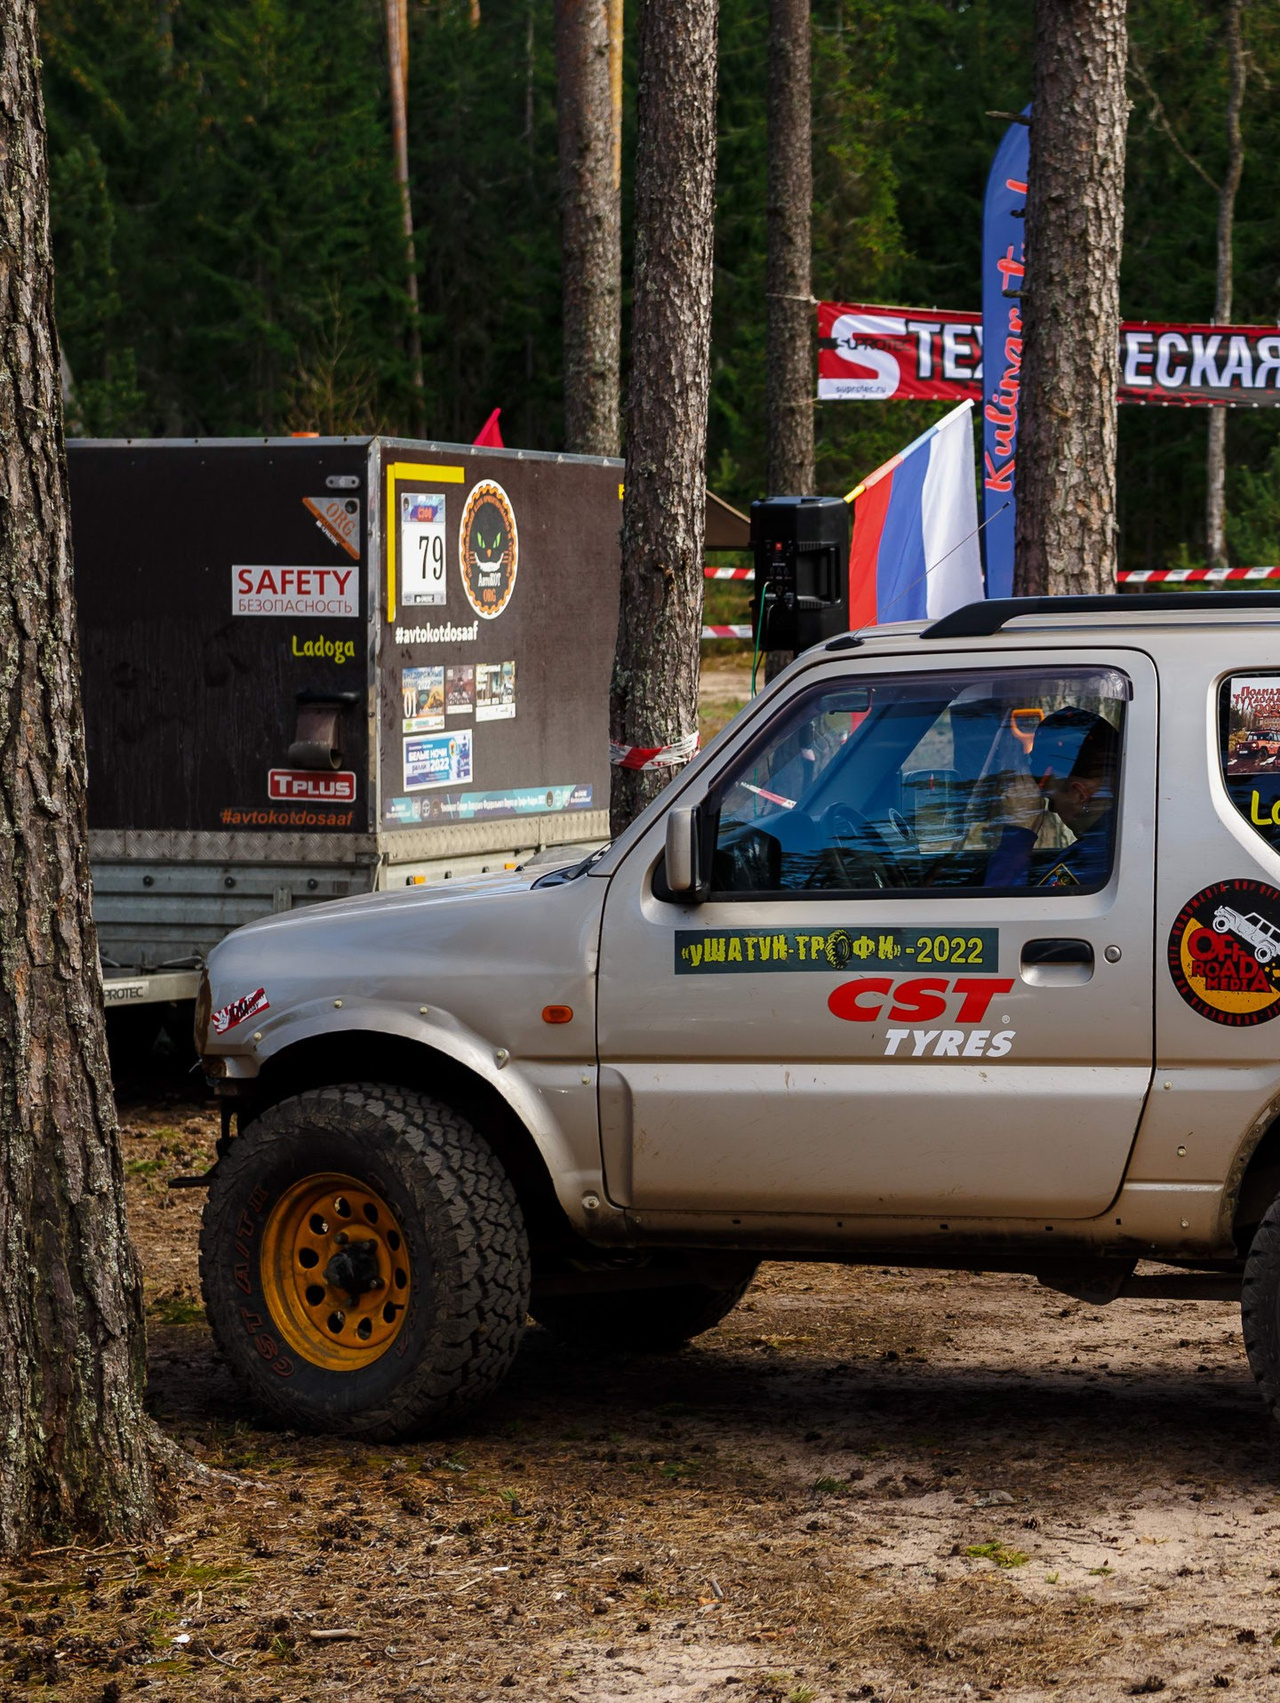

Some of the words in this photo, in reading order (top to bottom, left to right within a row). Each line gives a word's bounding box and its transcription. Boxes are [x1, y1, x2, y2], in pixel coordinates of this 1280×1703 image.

[835, 385, 887, 394] suprotec.ru
[326, 502, 356, 537] ORG
[418, 535, 443, 580] 79
[237, 568, 352, 596] SAFETY
[238, 598, 353, 614] БЕЗОПАСНОСТЬ
[395, 620, 479, 645] #avtokotdosaaf
[292, 634, 355, 664] Ladoga
[403, 690, 418, 719] 01
[274, 775, 350, 797] TPLUS
[221, 809, 354, 826] #avtokotdosaaf
[1191, 954, 1260, 979] ROAD
[1205, 967, 1273, 993] MEDIA
[104, 986, 143, 1001] PROTEC
[827, 977, 1016, 1024] CST
[884, 1029, 1016, 1057] TYRES
